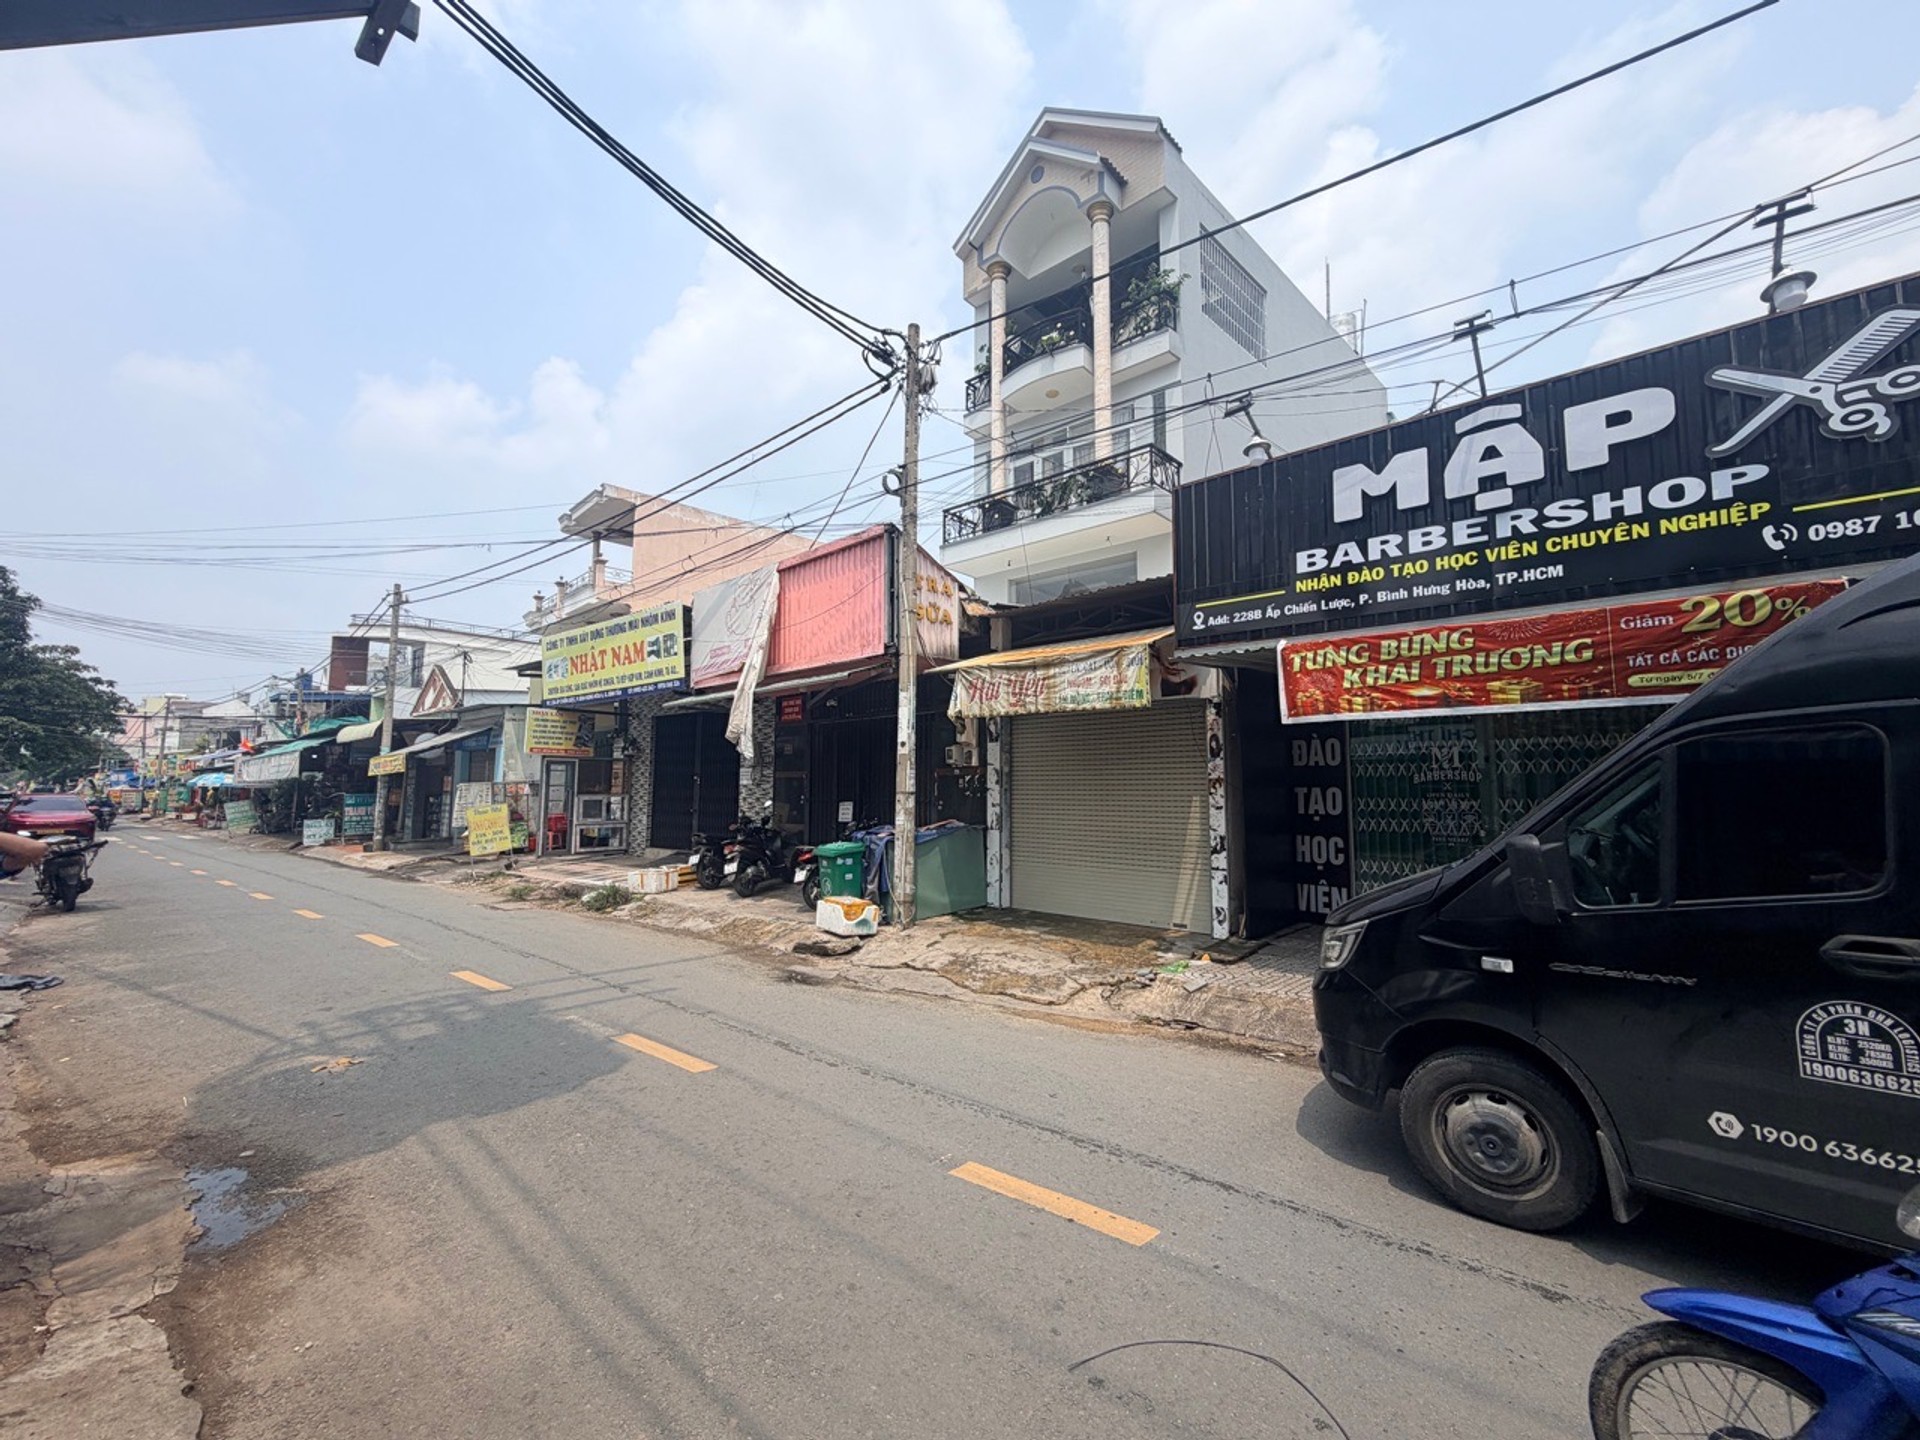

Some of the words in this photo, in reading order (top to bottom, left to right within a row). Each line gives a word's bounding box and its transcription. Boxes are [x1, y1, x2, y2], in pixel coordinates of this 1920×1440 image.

[1333, 386, 1677, 524] MẬP
[1295, 464, 1770, 575] BARBERSHOP
[1807, 514, 1882, 542] 0987
[1295, 573, 1342, 593] NHẬN
[1347, 565, 1385, 585] ĐÀO
[1390, 559, 1429, 579] TẠO
[1435, 550, 1479, 572] HỌC
[1485, 540, 1538, 563] VIÊN
[1544, 521, 1650, 553] CHUYÊN
[1659, 501, 1771, 535] NGHIỆP
[1207, 615, 1230, 627] Add:
[1232, 609, 1262, 623] 228B
[1265, 602, 1281, 619] Ấp
[1284, 599, 1317, 616] Chiến
[1321, 598, 1356, 611] Lược,
[1359, 594, 1373, 606] P.
[1376, 586, 1409, 603] Bình
[1412, 583, 1451, 599] Hưng
[1455, 577, 1491, 592] Hòa,
[1495, 564, 1565, 587] TP.HCM
[1619, 613, 1675, 631] Giảm
[1679, 589, 1812, 634] 20%
[545, 639, 559, 652] CÔNG
[568, 644, 608, 678] NHẬT
[610, 640, 646, 669] NAM
[1380, 627, 1477, 662] BỪNG
[1626, 650, 1654, 668] TẤT
[1659, 648, 1682, 665] CẢ
[1686, 646, 1721, 664] CÁC
[1342, 660, 1421, 690] KHAI
[1431, 637, 1596, 680] TRƯƠNG
[1638, 674, 1653, 684] Từ
[1655, 672, 1683, 685] ngày
[1687, 672, 1705, 681] 5/7
[1291, 733, 1342, 767] ĐÀO
[1413, 769, 1483, 784] BARBERSHOP
[1294, 786, 1344, 822] TẠO
[1296, 834, 1346, 871] HỌC
[1297, 878, 1349, 915] VIÊN
[1750, 1123, 1818, 1152] 1900
[1823, 1139, 1920, 1176] 63662
